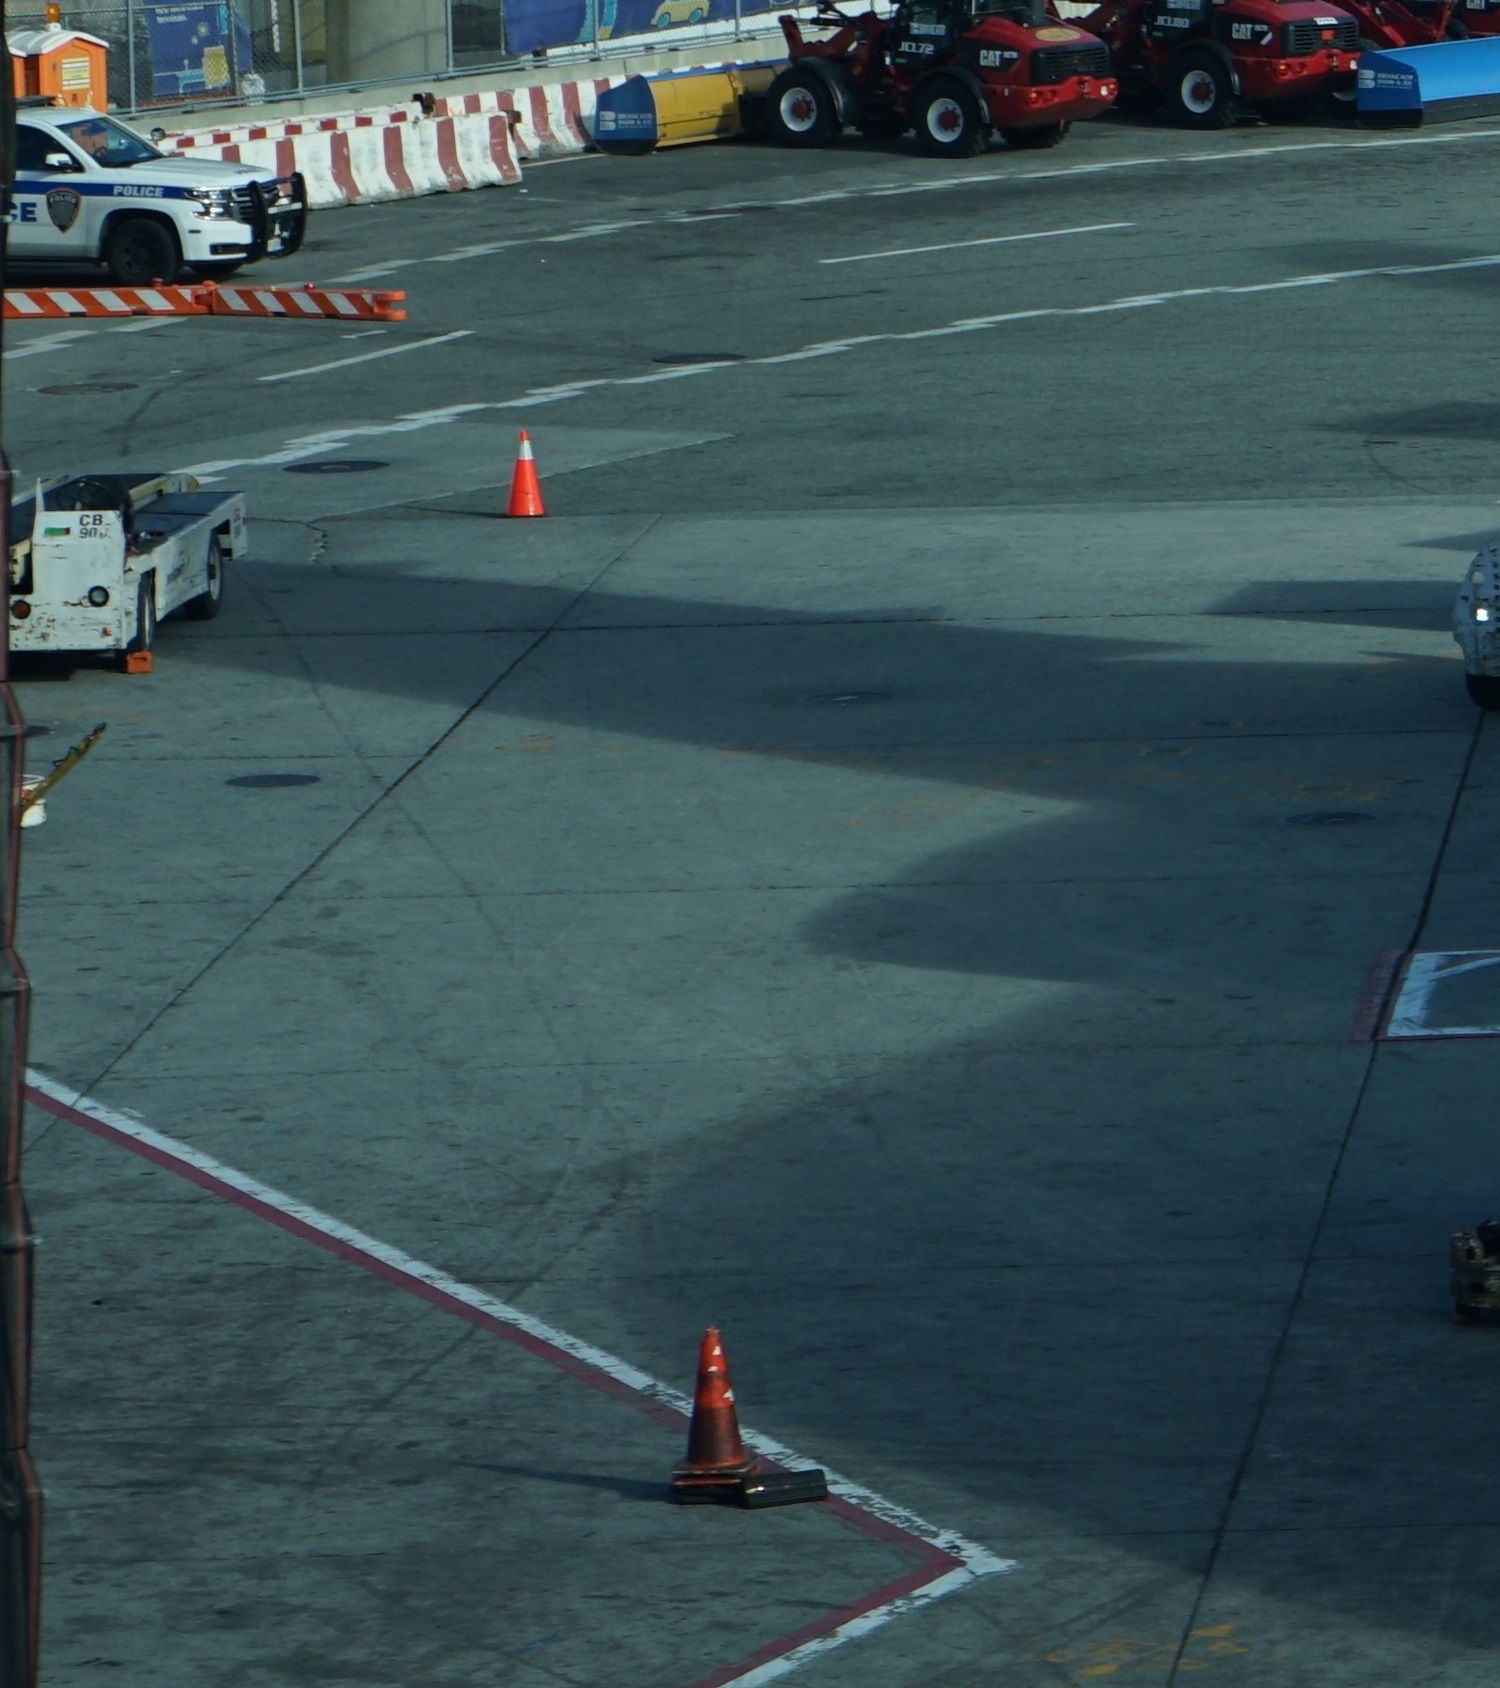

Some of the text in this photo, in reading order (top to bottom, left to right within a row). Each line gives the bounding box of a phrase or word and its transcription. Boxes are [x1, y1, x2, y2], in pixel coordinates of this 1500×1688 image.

[1232, 23, 1253, 40] CAT
[980, 50, 1002, 67] CAT
[112, 185, 165, 198] POLICE
